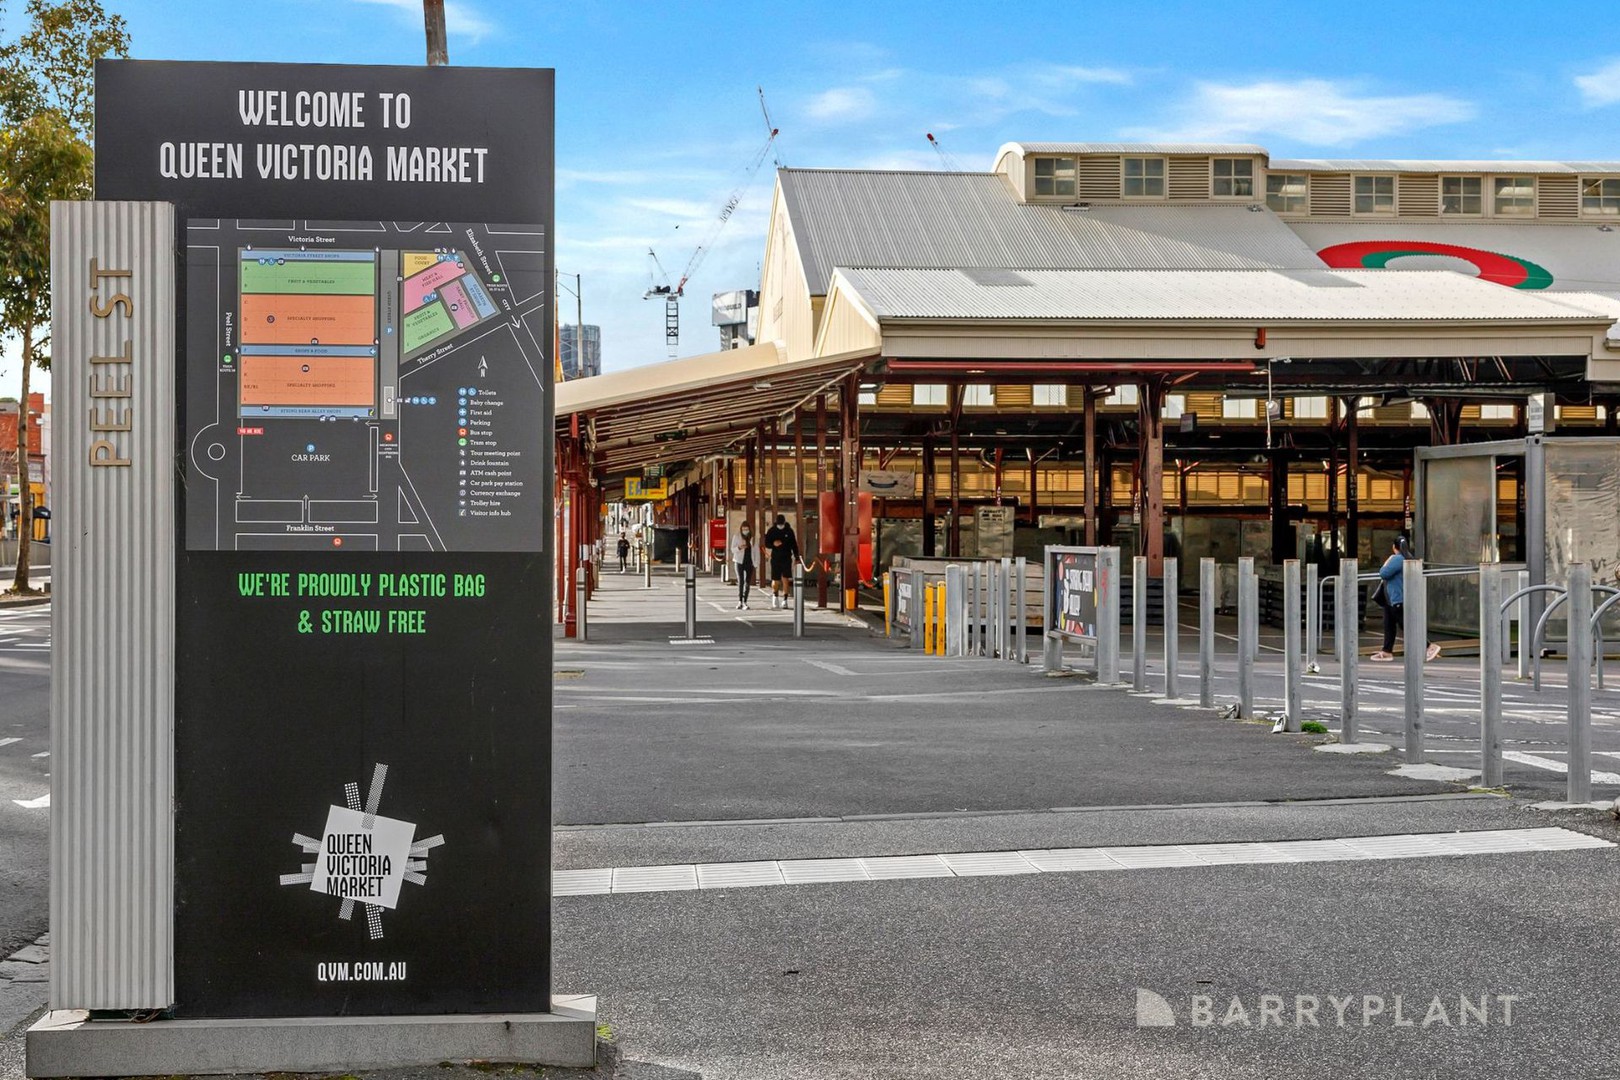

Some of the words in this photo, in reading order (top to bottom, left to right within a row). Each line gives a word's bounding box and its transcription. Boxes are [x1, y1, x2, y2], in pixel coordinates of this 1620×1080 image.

[239, 90, 365, 127] WELCOME
[379, 93, 411, 129] TO
[160, 141, 243, 179] QUEEN
[257, 144, 373, 181] VICTORIA
[387, 146, 488, 183] MARKET
[287, 235, 315, 243] Victoria
[465, 228, 484, 257] Elizabeth
[480, 255, 493, 275] Street
[89, 257, 133, 318] ST
[502, 298, 512, 311] CITY
[225, 312, 233, 326] Peel
[225, 327, 233, 347] Street
[416, 351, 437, 365] Therry
[435, 343, 454, 355] Street
[89, 339, 133, 467] PEEL
[484, 399, 504, 407] change
[470, 419, 491, 427] Parking
[286, 524, 314, 532] Franklin
[238, 573, 290, 596] WE'RE
[298, 573, 371, 596] PROUDLY
[379, 573, 446, 597] PLASTIC
[454, 574, 486, 597] BAG
[298, 609, 313, 633] &
[322, 610, 380, 634] STRAW
[388, 610, 426, 634] FREE
[327, 834, 372, 854] QUEEN
[327, 855, 391, 876] VICTORIA
[326, 876, 384, 897] MARKET
[317, 962, 407, 982] QVM.COM.AU
